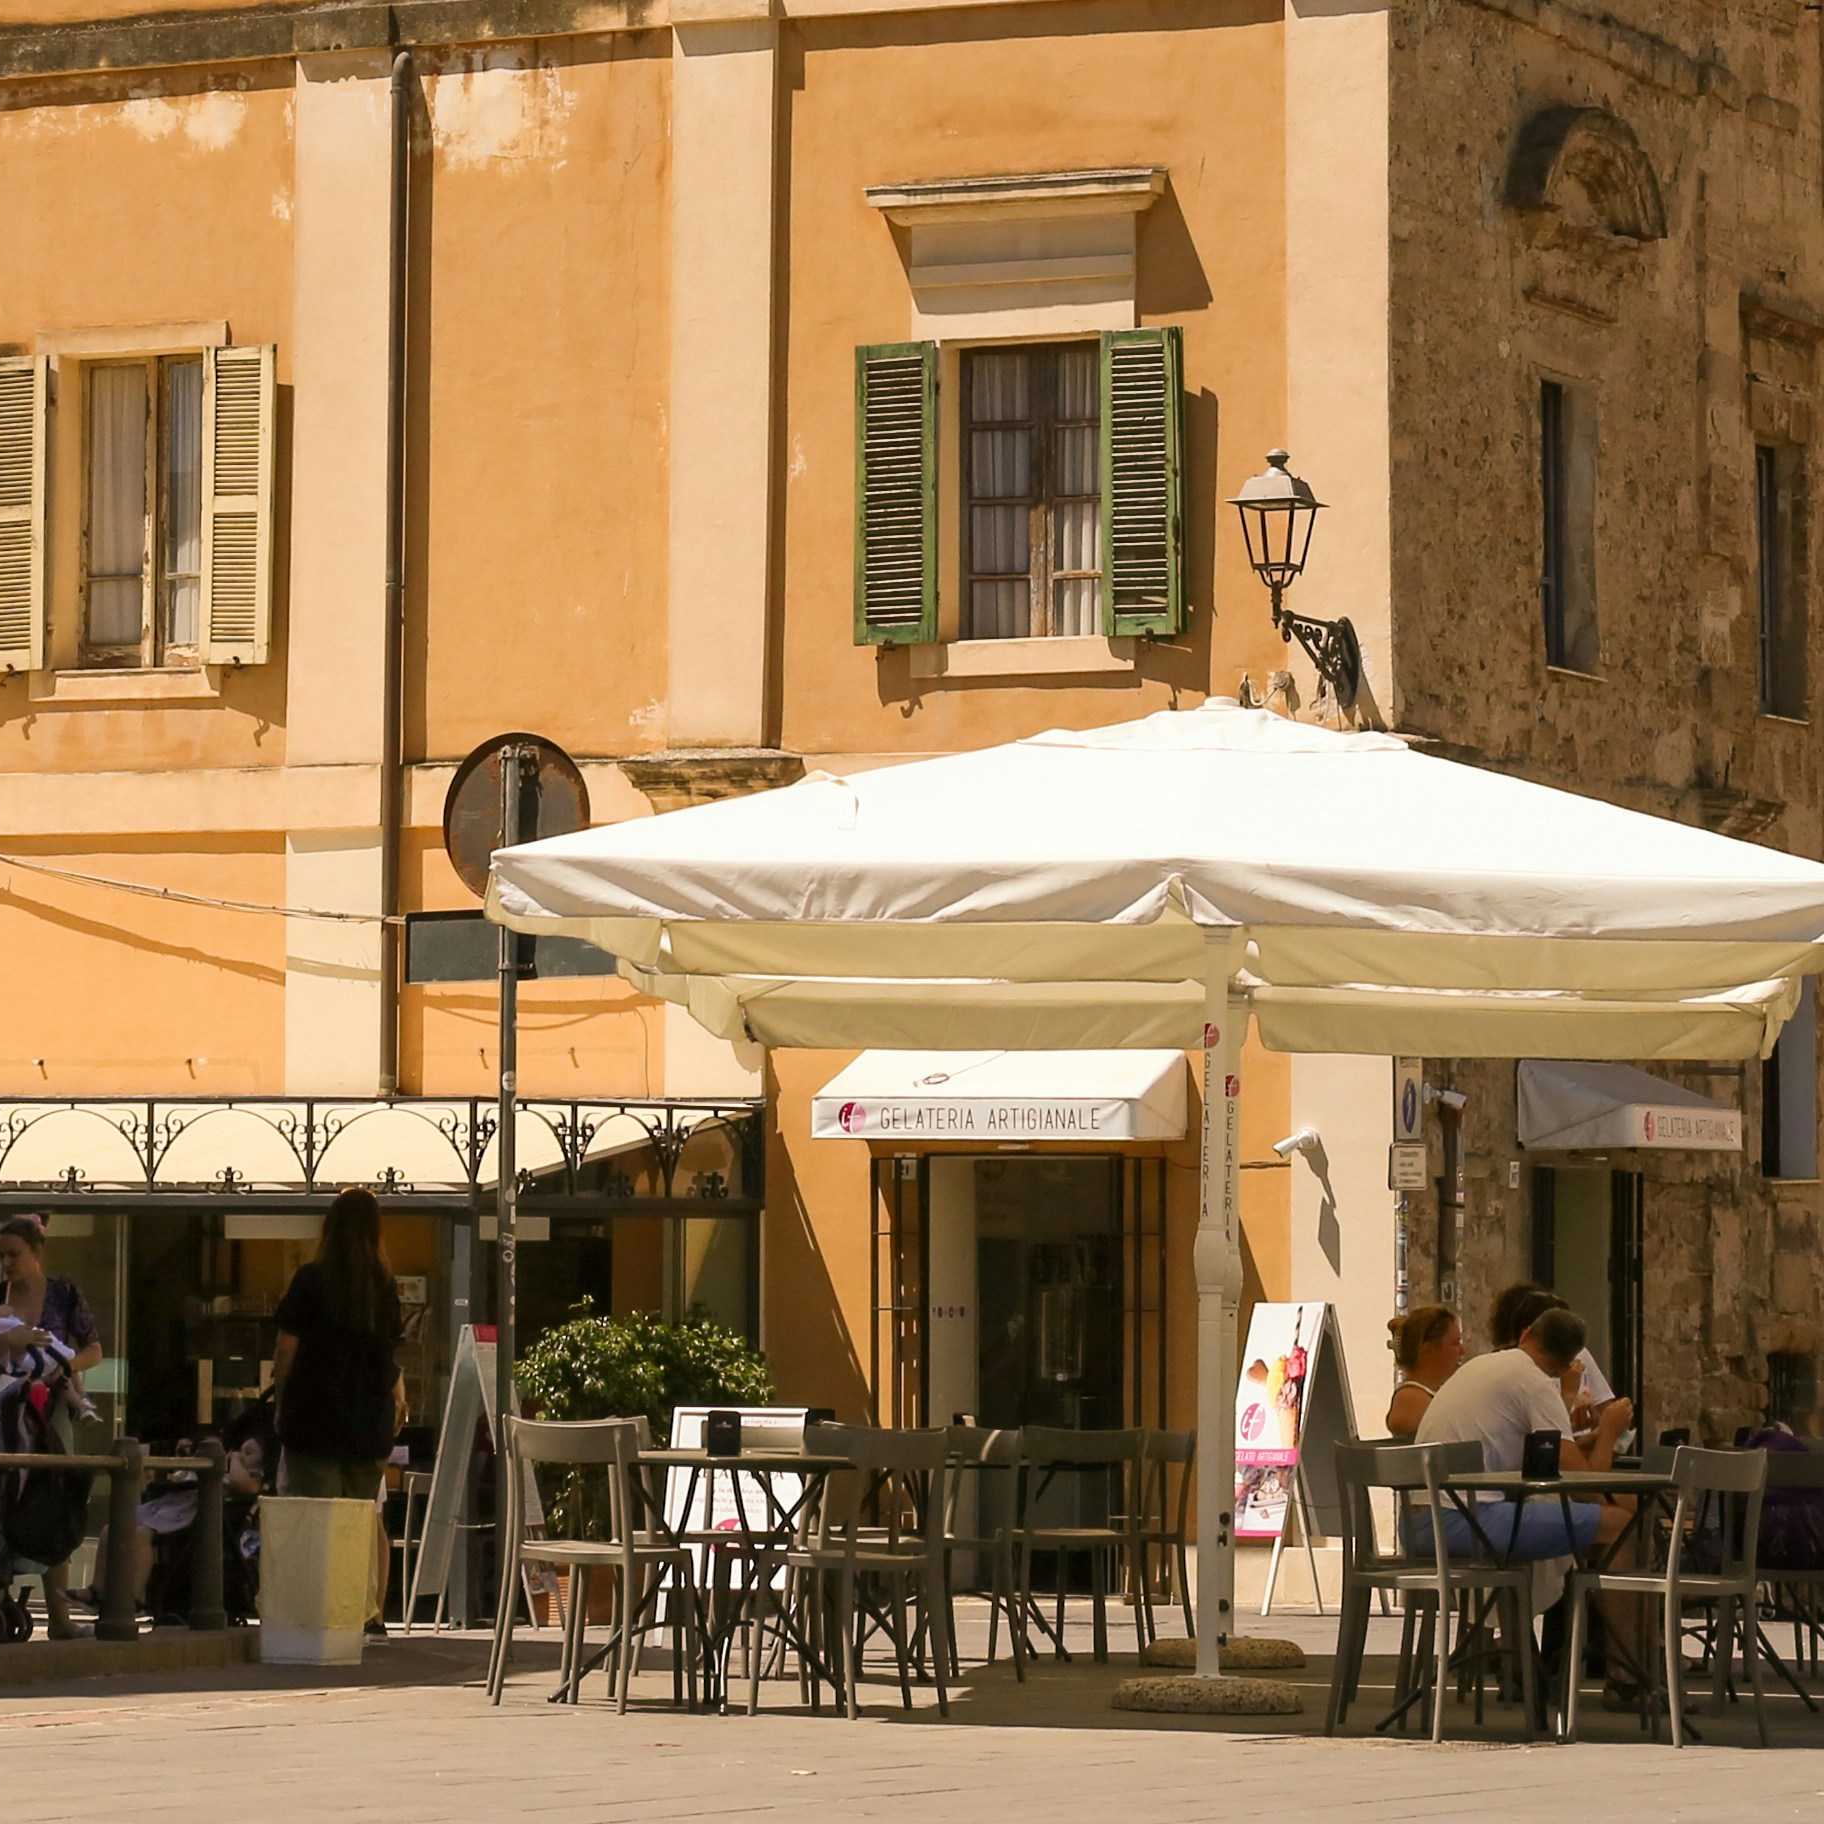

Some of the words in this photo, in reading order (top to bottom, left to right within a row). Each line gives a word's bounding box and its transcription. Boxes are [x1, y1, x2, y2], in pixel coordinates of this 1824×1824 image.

[880, 1108, 975, 1130] GELATERIA
[987, 1107, 1100, 1130] ARTIGIANALE
[1202, 1052, 1211, 1217] GELATERIA
[1225, 1100, 1235, 1242] GELATERIA
